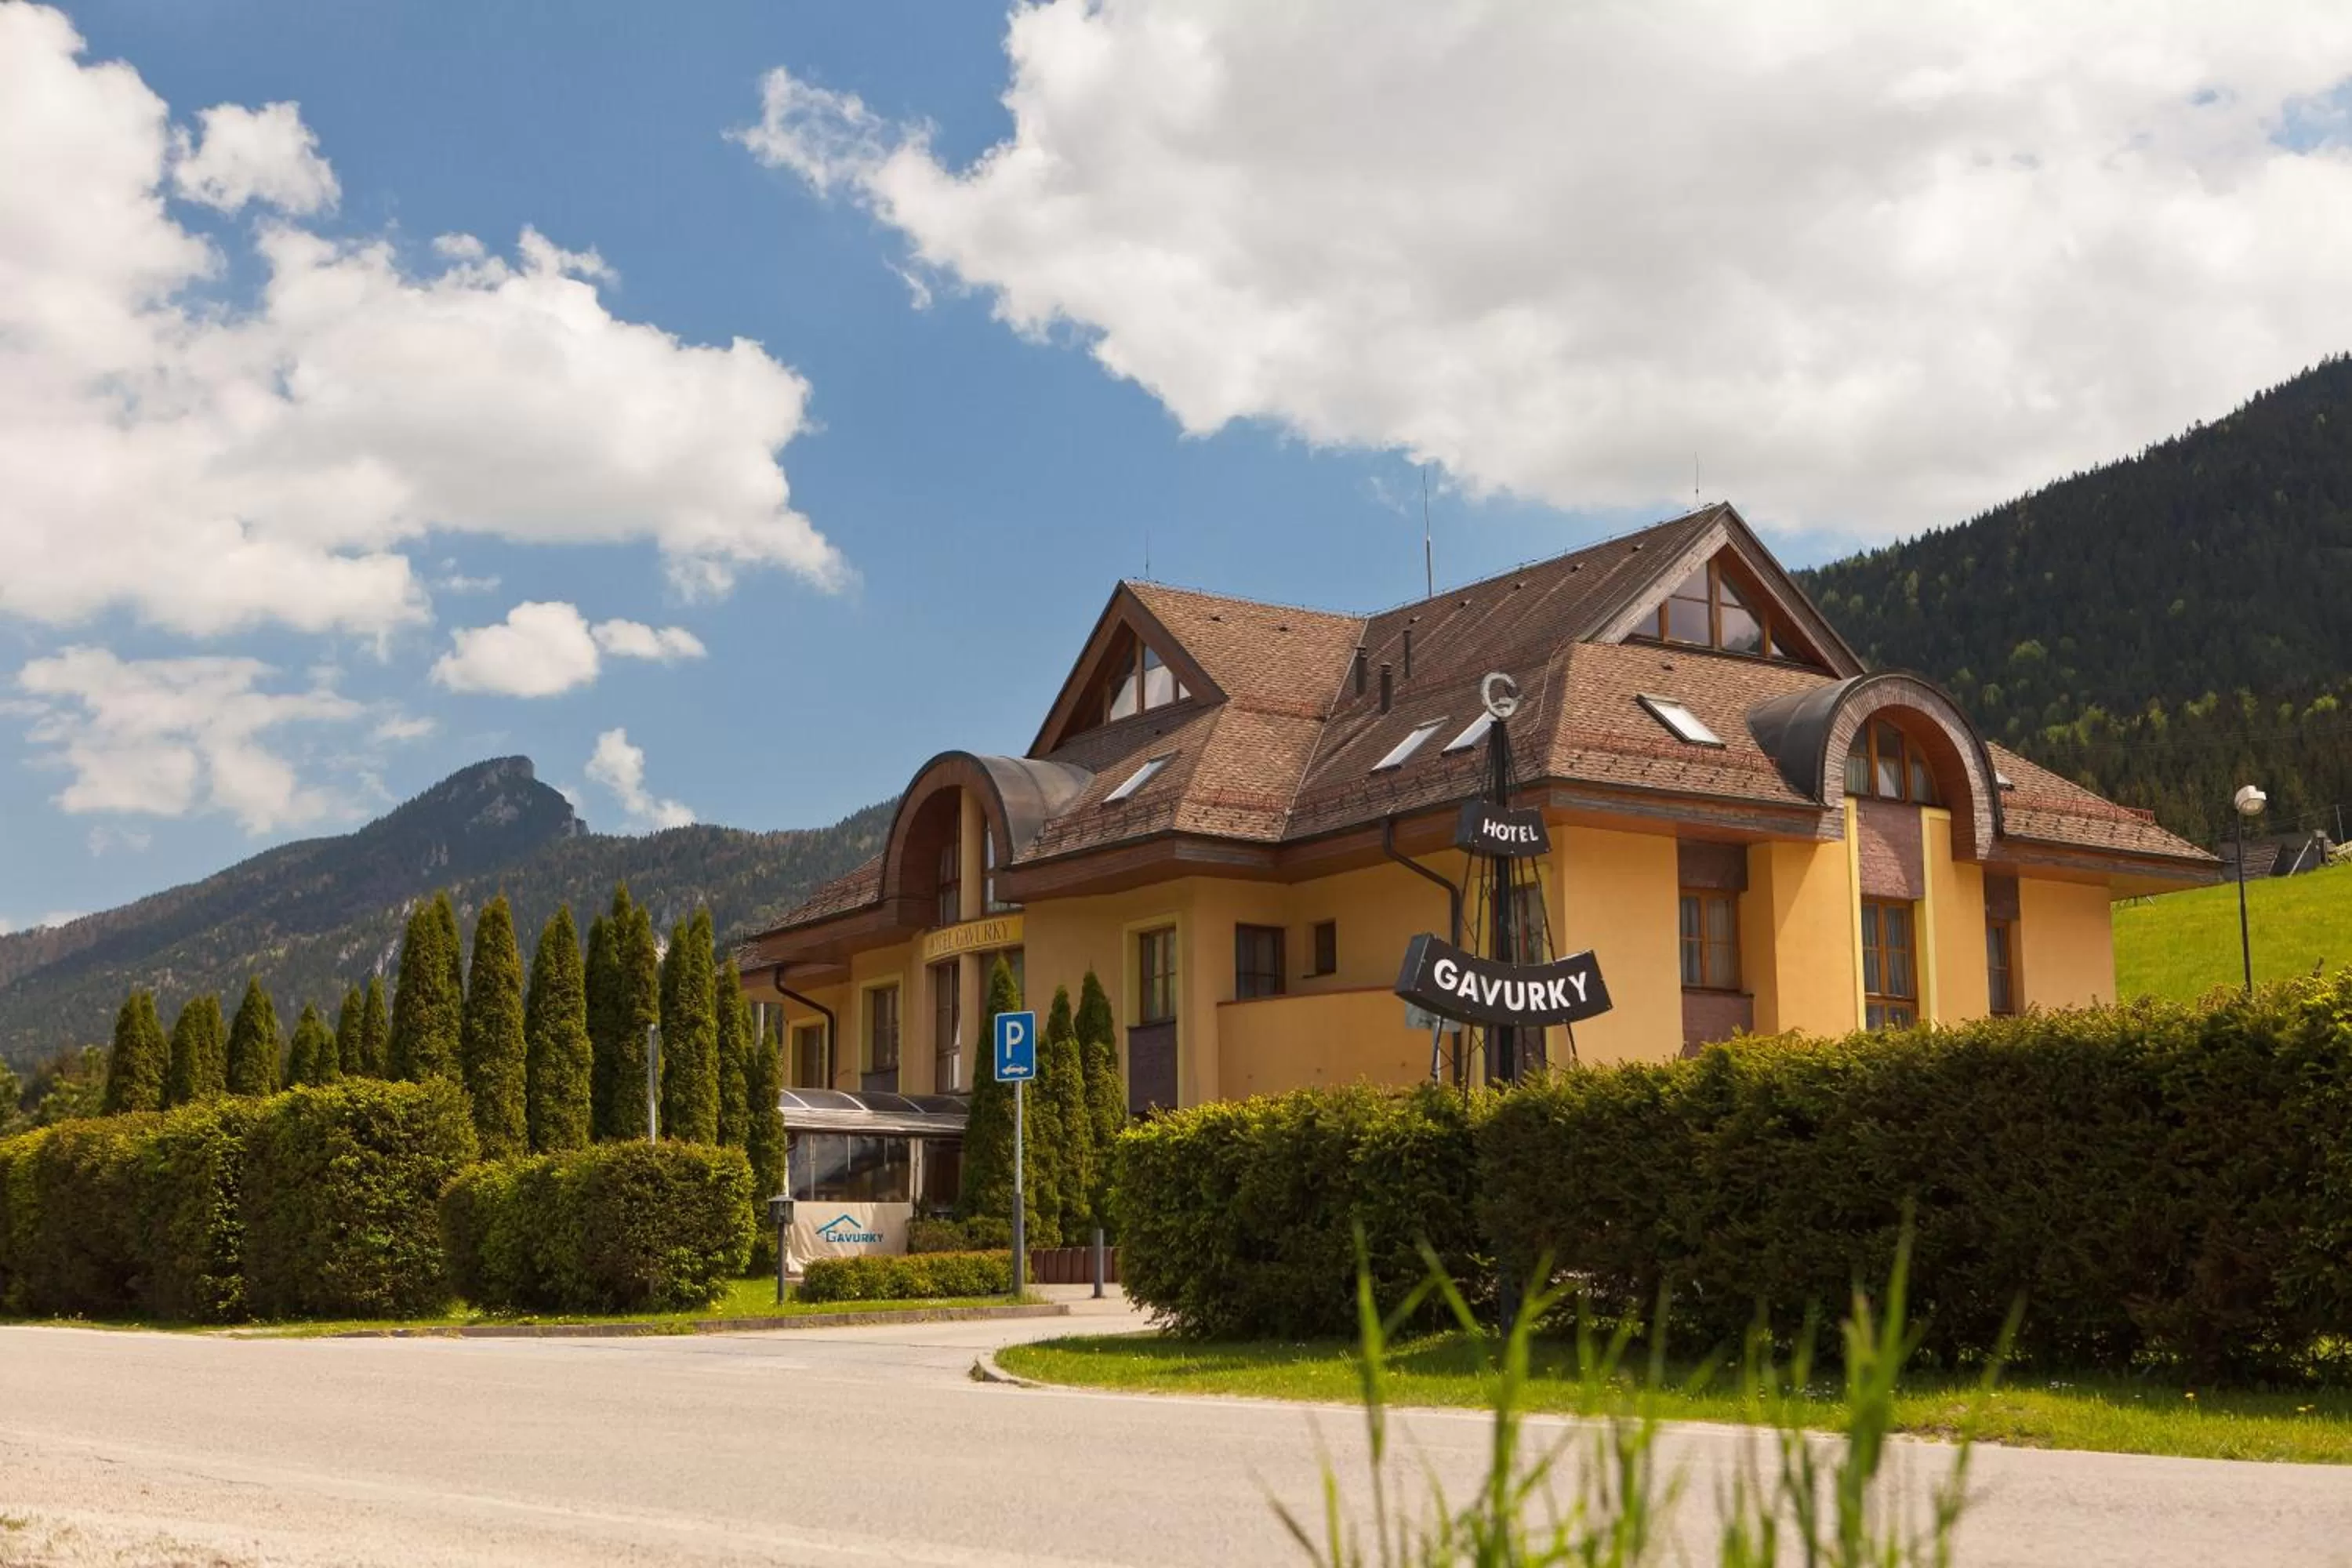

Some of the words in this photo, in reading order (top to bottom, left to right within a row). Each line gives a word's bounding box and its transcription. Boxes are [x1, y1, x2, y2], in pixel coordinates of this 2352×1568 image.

[1483, 818, 1539, 843] HOTEL
[1433, 958, 1588, 1011] GAVURKY
[1006, 1021, 1025, 1059] P
[826, 1230, 884, 1243] GAVURKY
